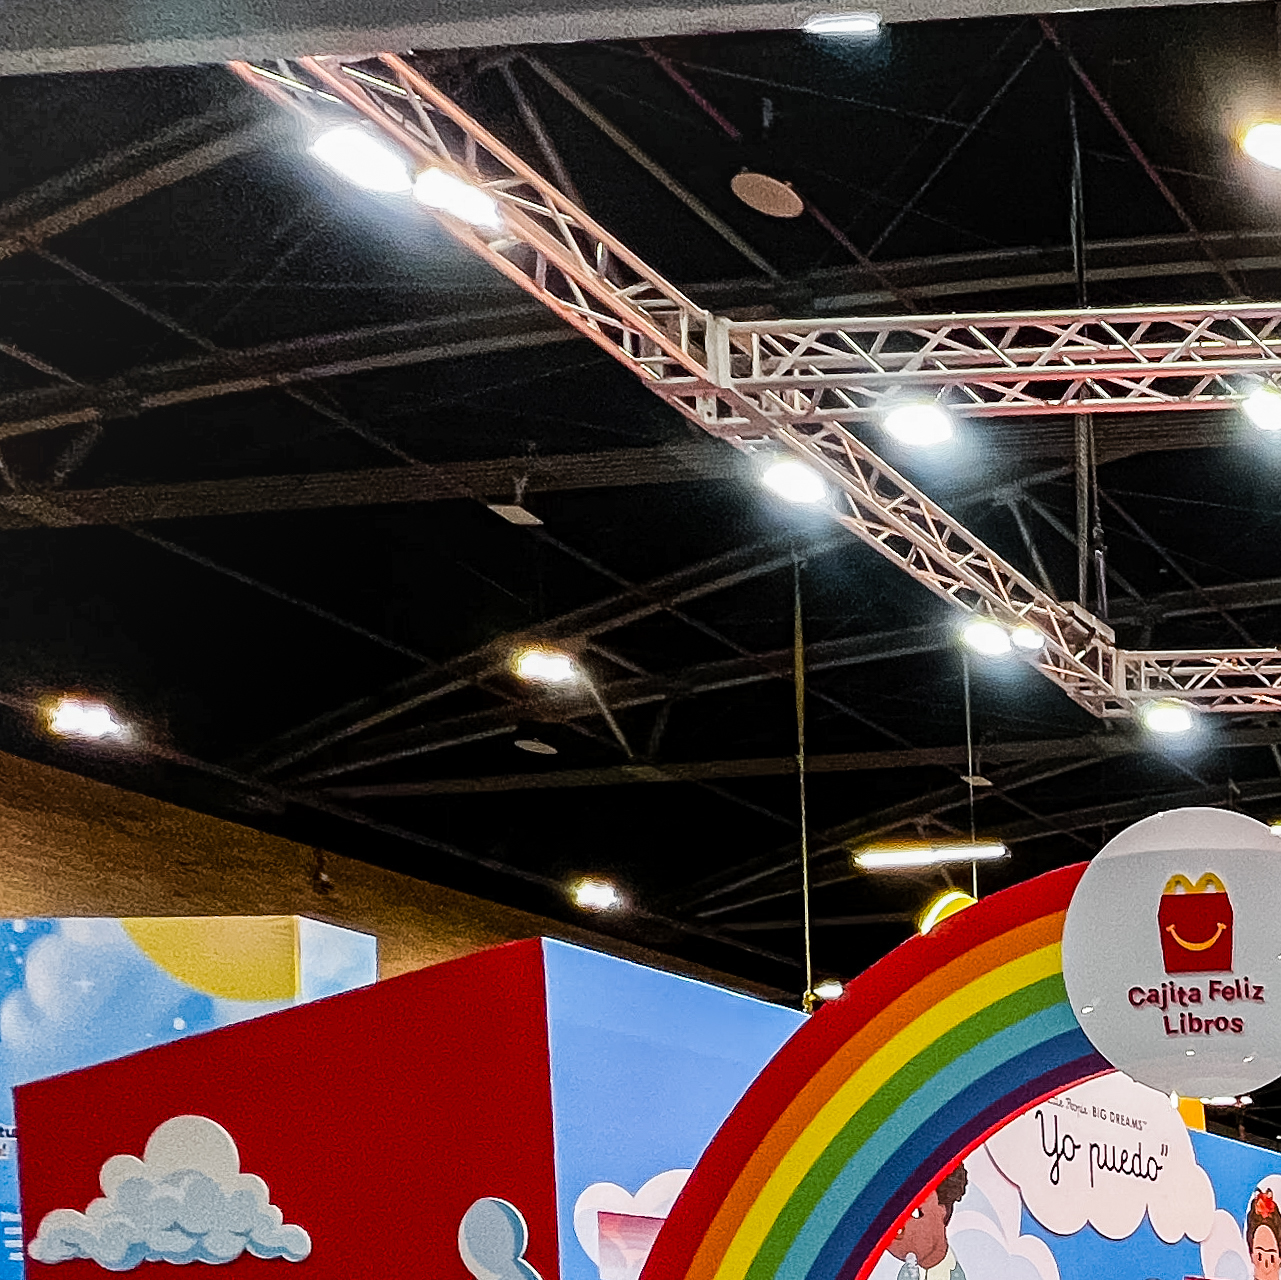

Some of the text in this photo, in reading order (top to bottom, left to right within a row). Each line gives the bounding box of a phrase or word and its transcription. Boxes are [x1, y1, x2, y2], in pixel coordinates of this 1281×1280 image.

[1128, 977, 1266, 1011] Cajita Feliz
[1163, 1013, 1243, 1036] Libros
[1092, 1106, 1107, 1120] BIG
[1035, 1110, 1081, 1185] Yo
